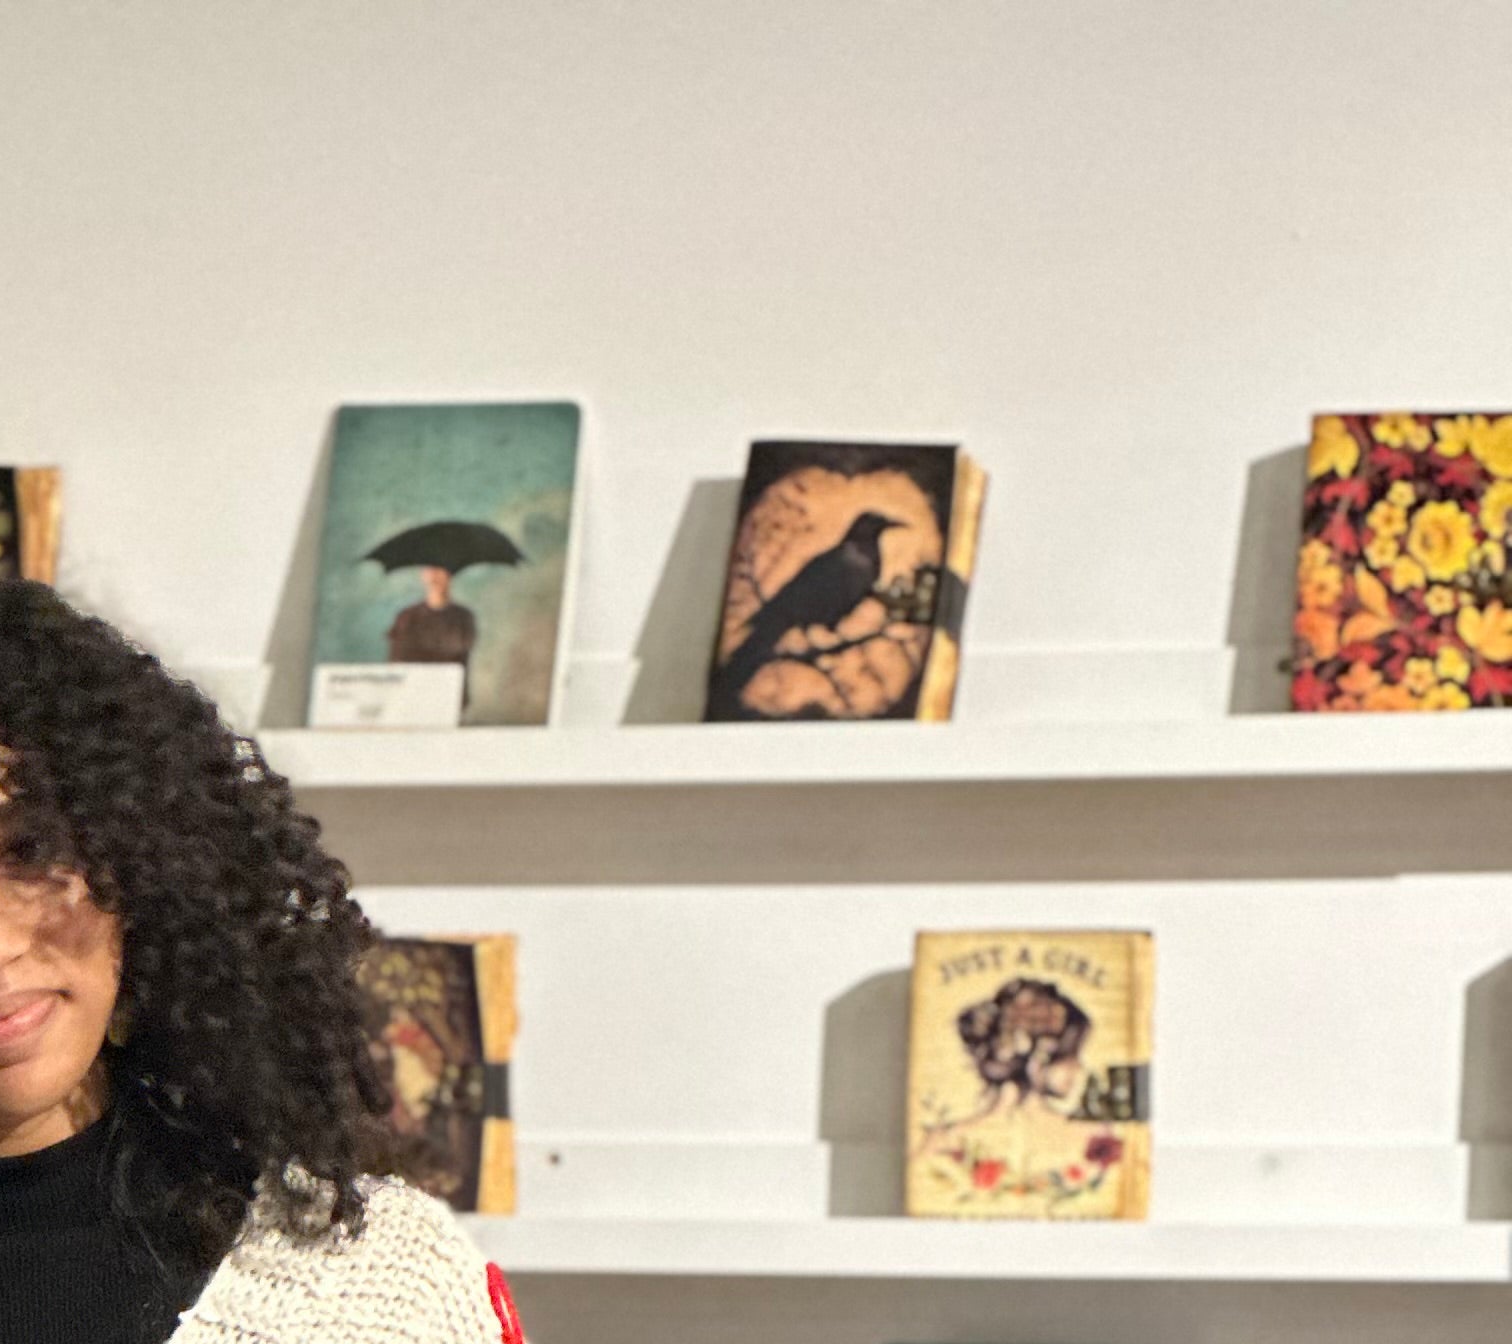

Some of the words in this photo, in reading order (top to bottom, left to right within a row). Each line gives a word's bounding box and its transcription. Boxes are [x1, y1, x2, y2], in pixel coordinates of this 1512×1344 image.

[939, 947, 1005, 984] JUST
[1017, 947, 1033, 965] A
[1043, 947, 1108, 989] GIRL
